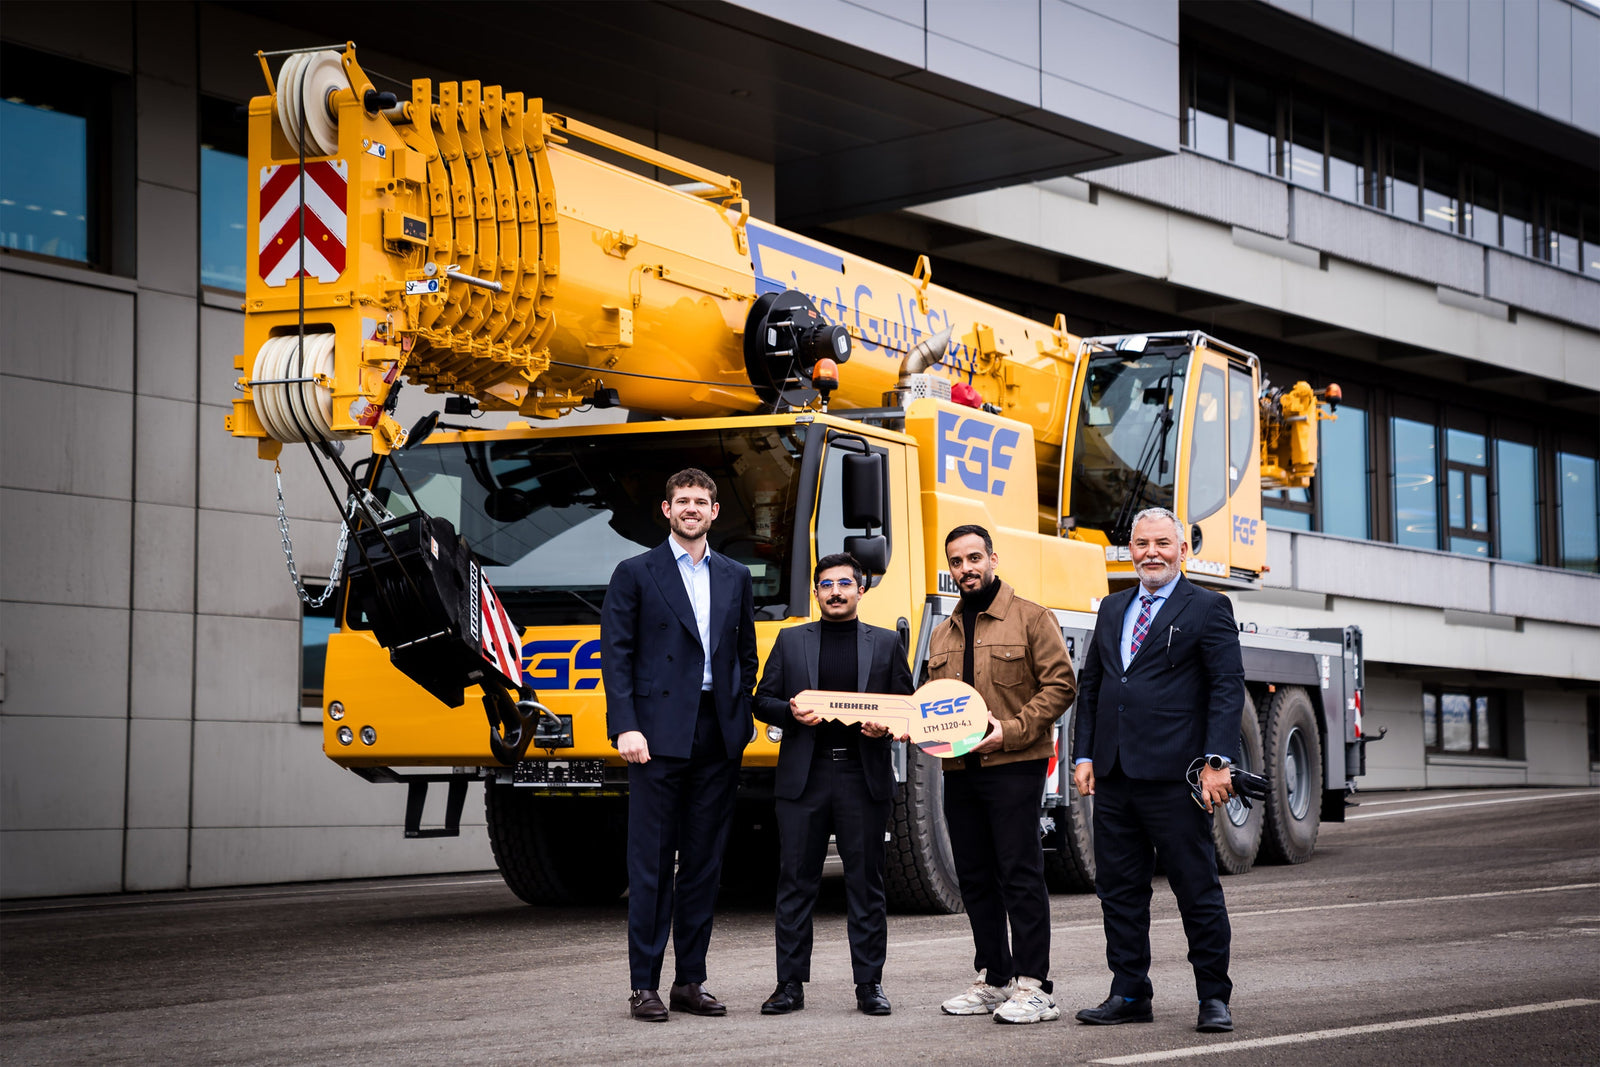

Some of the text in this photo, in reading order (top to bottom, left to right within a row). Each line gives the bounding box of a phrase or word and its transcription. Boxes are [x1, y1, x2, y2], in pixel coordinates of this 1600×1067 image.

[745, 223, 978, 387] Fst Gulf Sky
[521, 639, 602, 690] GS
[829, 702, 879, 711] LIEBHERR
[923, 720, 972, 734] LTM 1120-4.1
